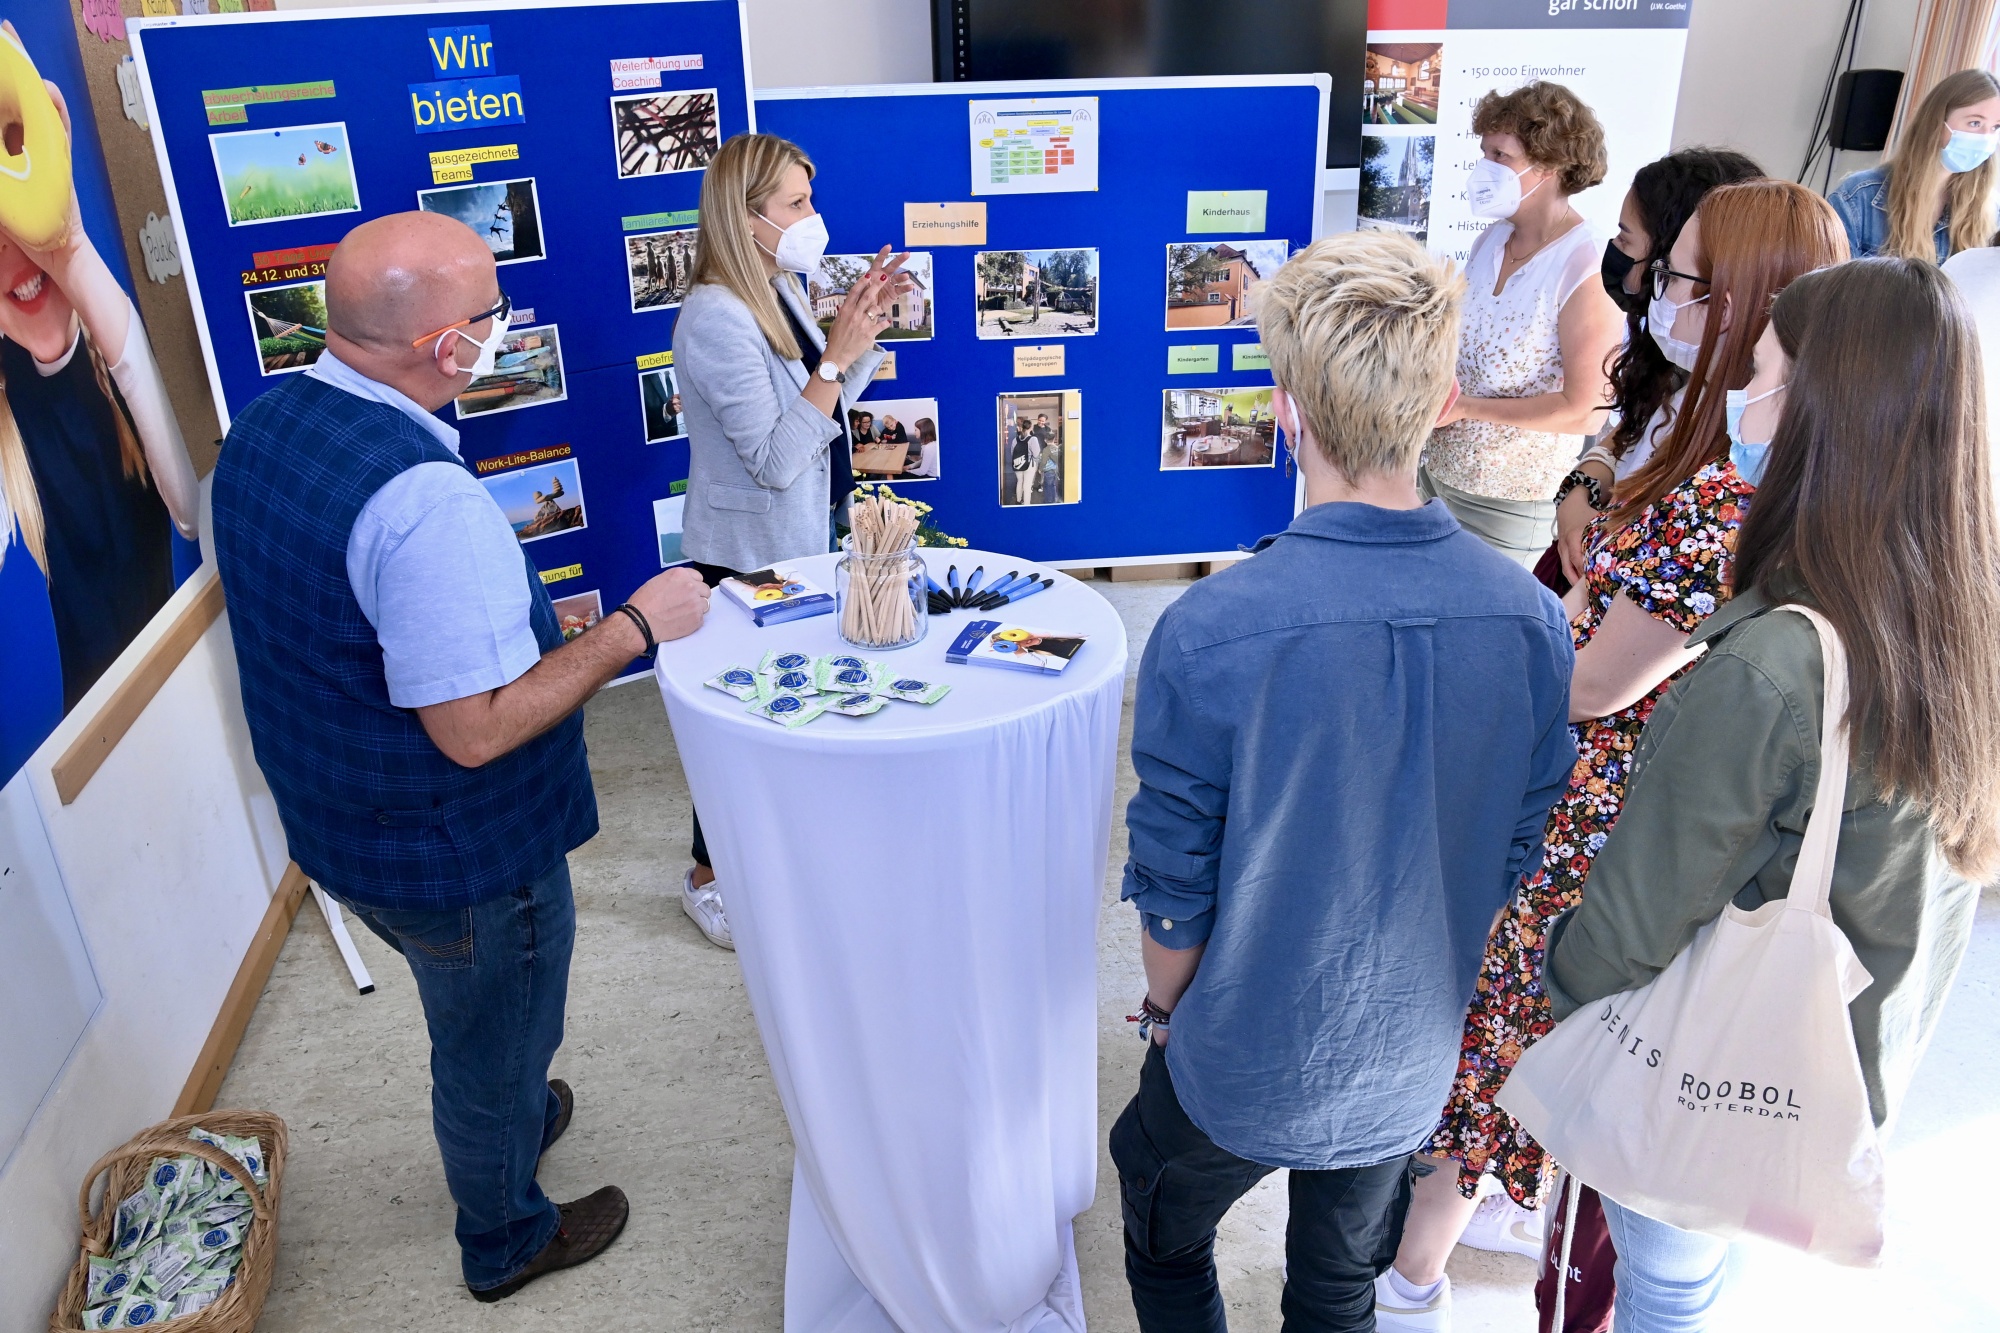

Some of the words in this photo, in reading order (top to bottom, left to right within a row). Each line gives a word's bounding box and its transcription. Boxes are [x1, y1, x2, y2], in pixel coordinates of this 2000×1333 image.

[428, 34, 493, 71] Wir
[610, 59, 681, 72] Weiterbildung
[683, 57, 703, 68] und
[1471, 67, 1490, 79] 150
[1493, 67, 1518, 76] 000
[1521, 64, 1586, 76] Einwohner
[612, 75, 661, 88] Coaching
[203, 83, 336, 105] abwechslungsreiche
[207, 109, 248, 123] Arbeit
[411, 88, 524, 126] bieten
[430, 148, 520, 166] ausgezeichnete
[433, 168, 473, 181] Teams
[1202, 208, 1251, 217] Kinderhaus
[912, 220, 980, 230] Erziehungshilfe
[241, 268, 282, 285] 24.12.
[284, 265, 309, 279] und
[475, 446, 572, 472] Work-Life-Balance
[569, 565, 583, 577] für
[1600, 1003, 1662, 1068] DENIS
[1680, 1072, 1802, 1110] ROOBOL
[1677, 1095, 1800, 1122] ROTTERDAM
